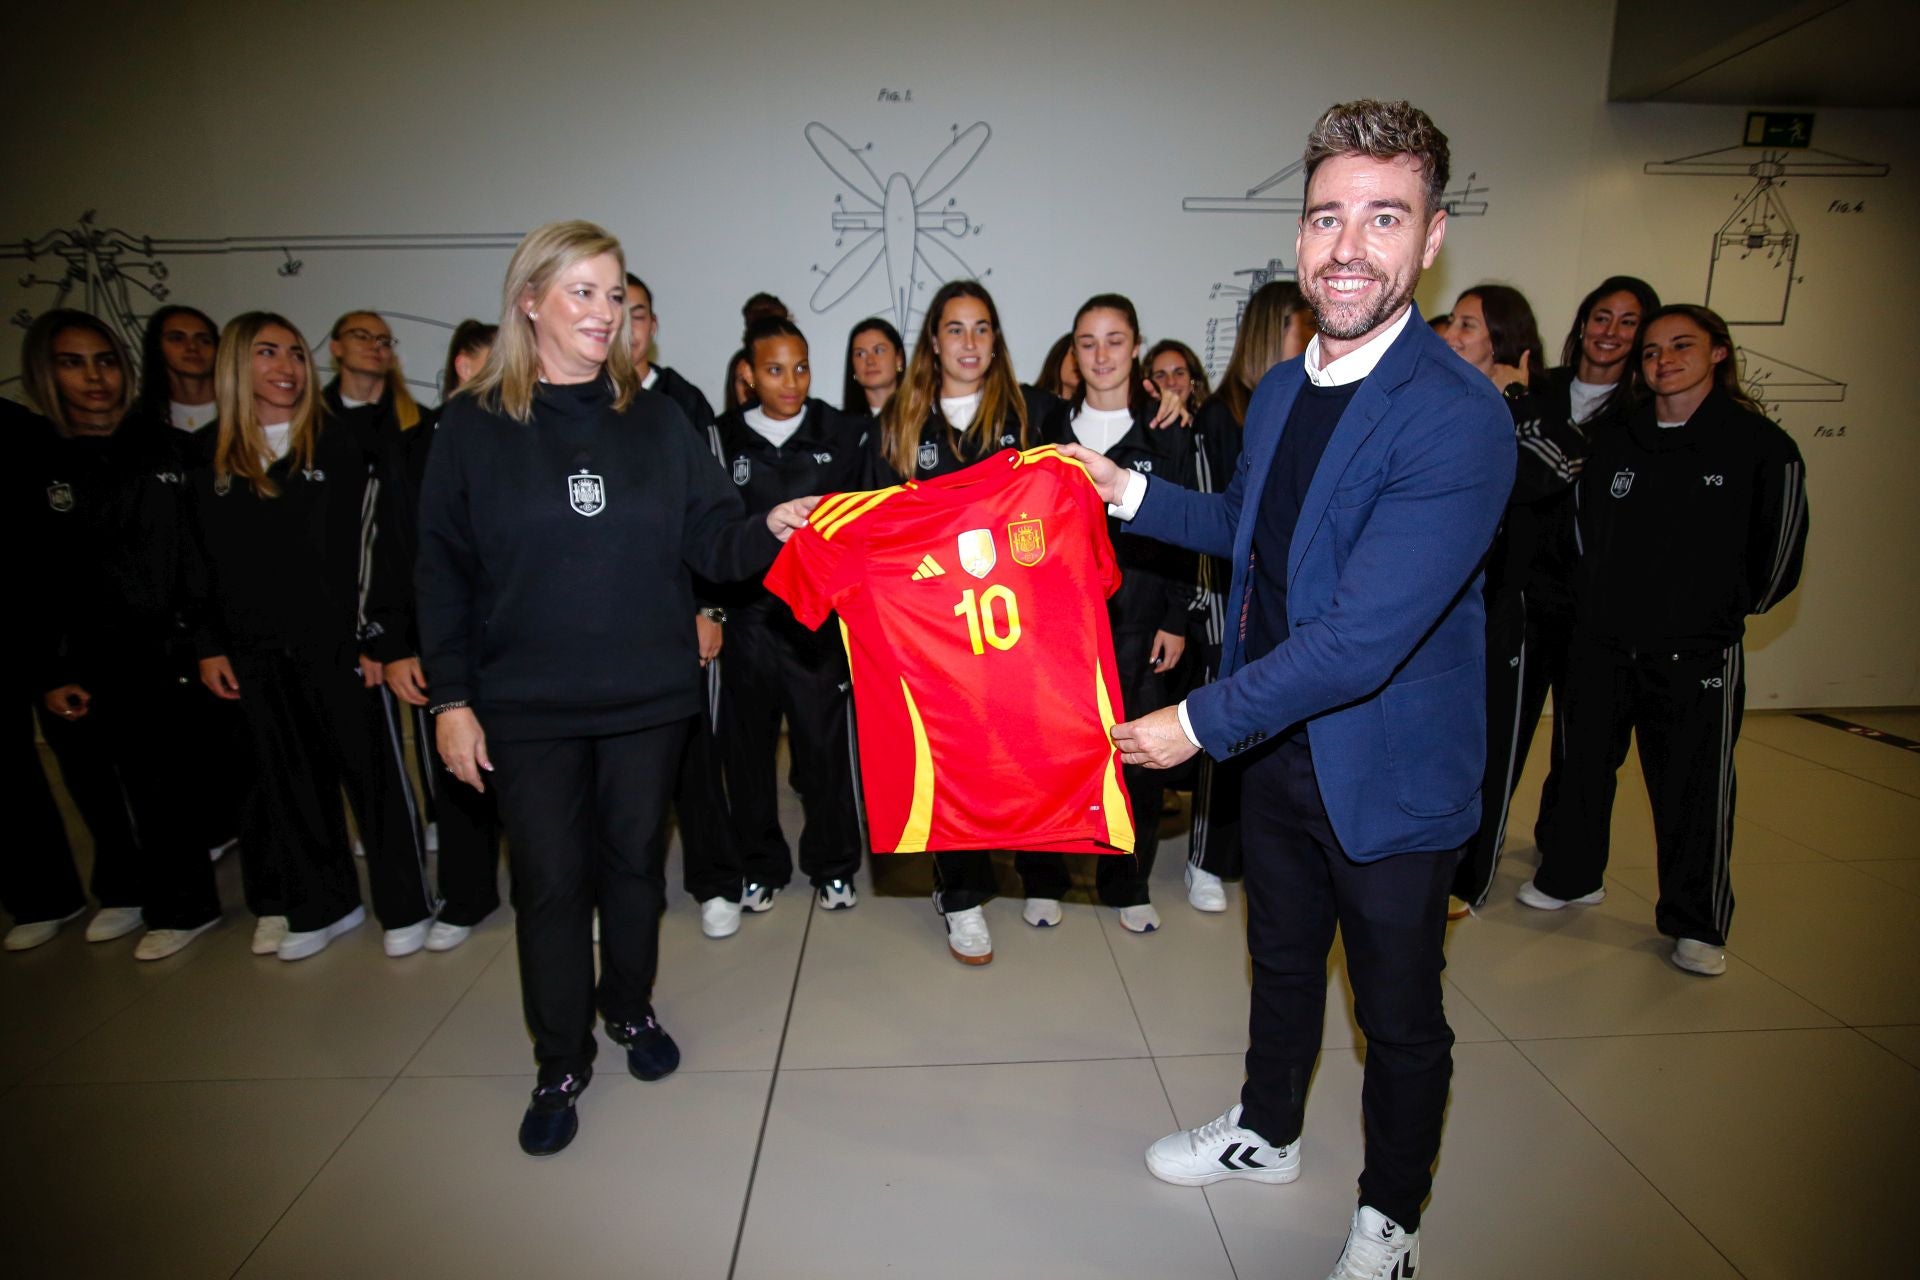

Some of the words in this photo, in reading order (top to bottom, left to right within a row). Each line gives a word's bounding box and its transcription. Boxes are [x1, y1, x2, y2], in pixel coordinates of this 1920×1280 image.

[1703, 474, 1724, 486] Y-3
[953, 584, 1022, 656] 10
[1700, 677, 1723, 689] Y-3
